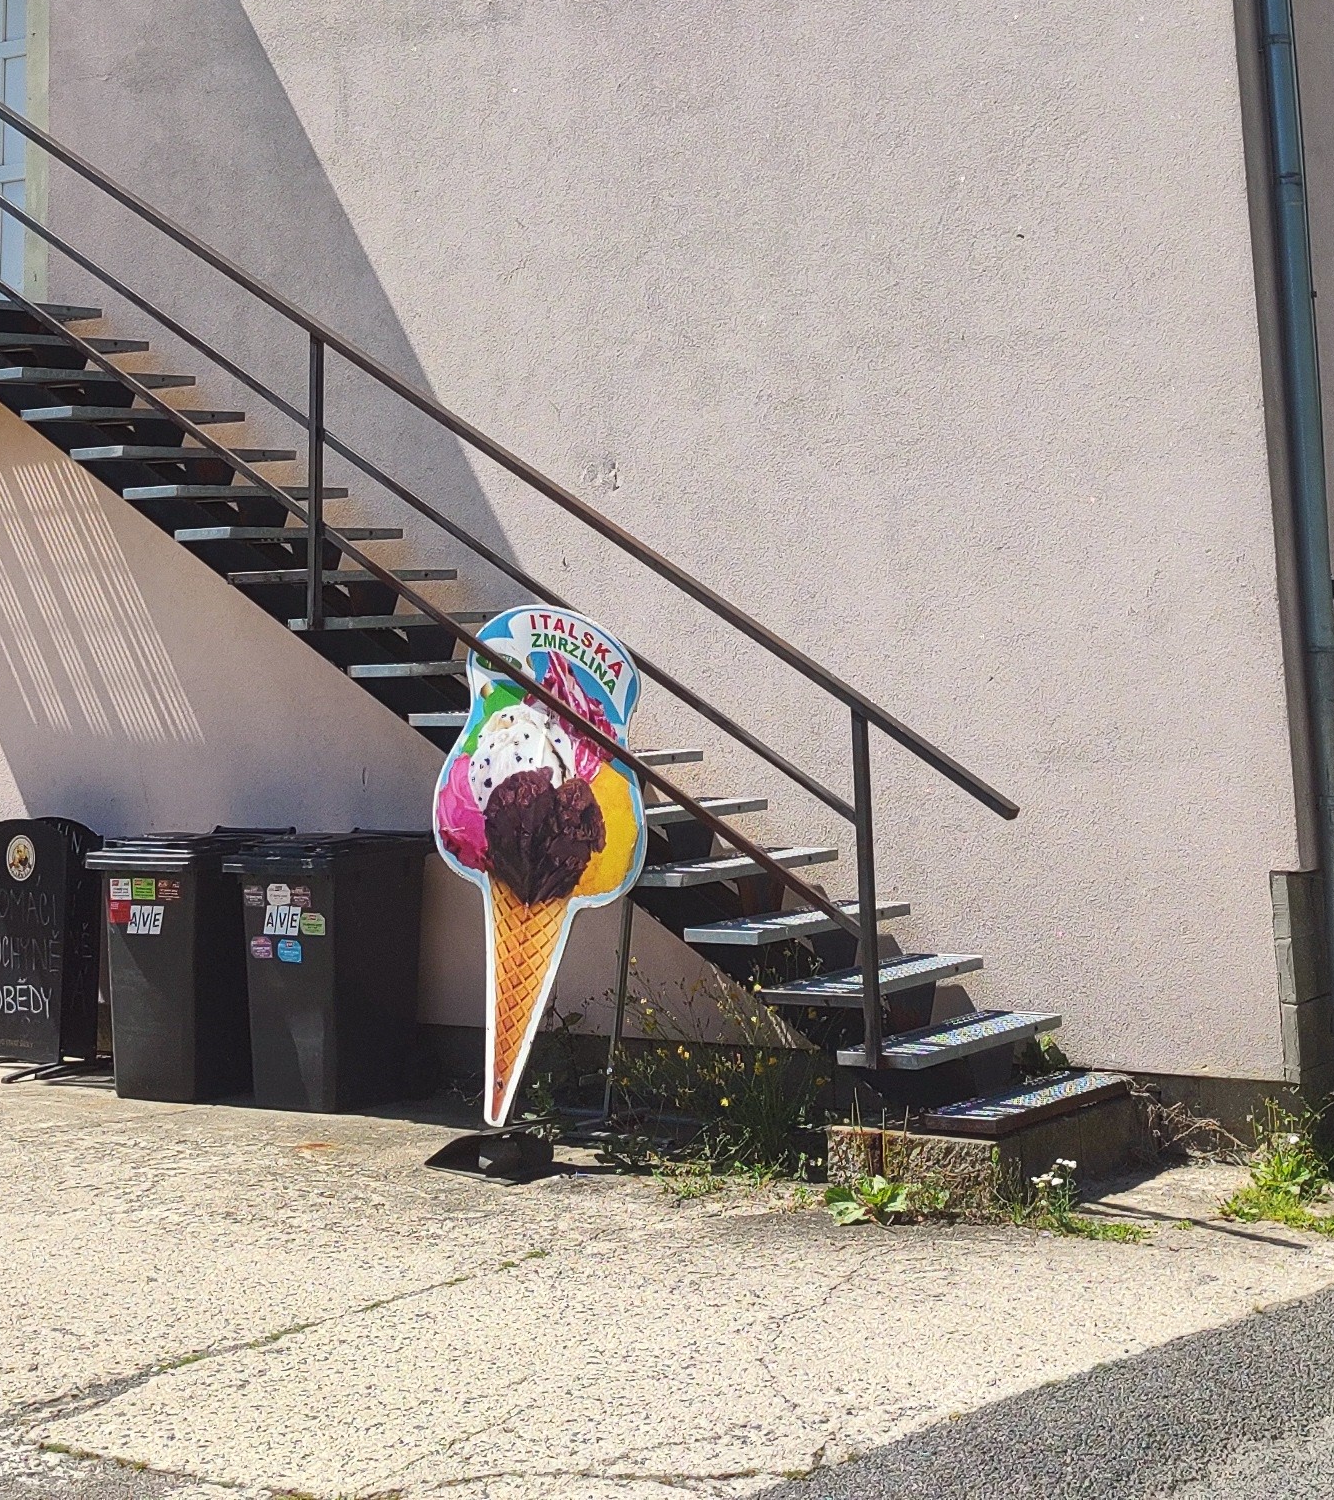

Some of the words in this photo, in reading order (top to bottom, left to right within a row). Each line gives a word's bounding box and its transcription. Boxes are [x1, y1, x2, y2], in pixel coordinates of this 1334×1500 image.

[530, 614, 625, 680] ITALSKÁ
[531, 633, 616, 695] ZMRZLINA
[130, 912, 162, 927] AVE
[267, 912, 299, 928] AVE
